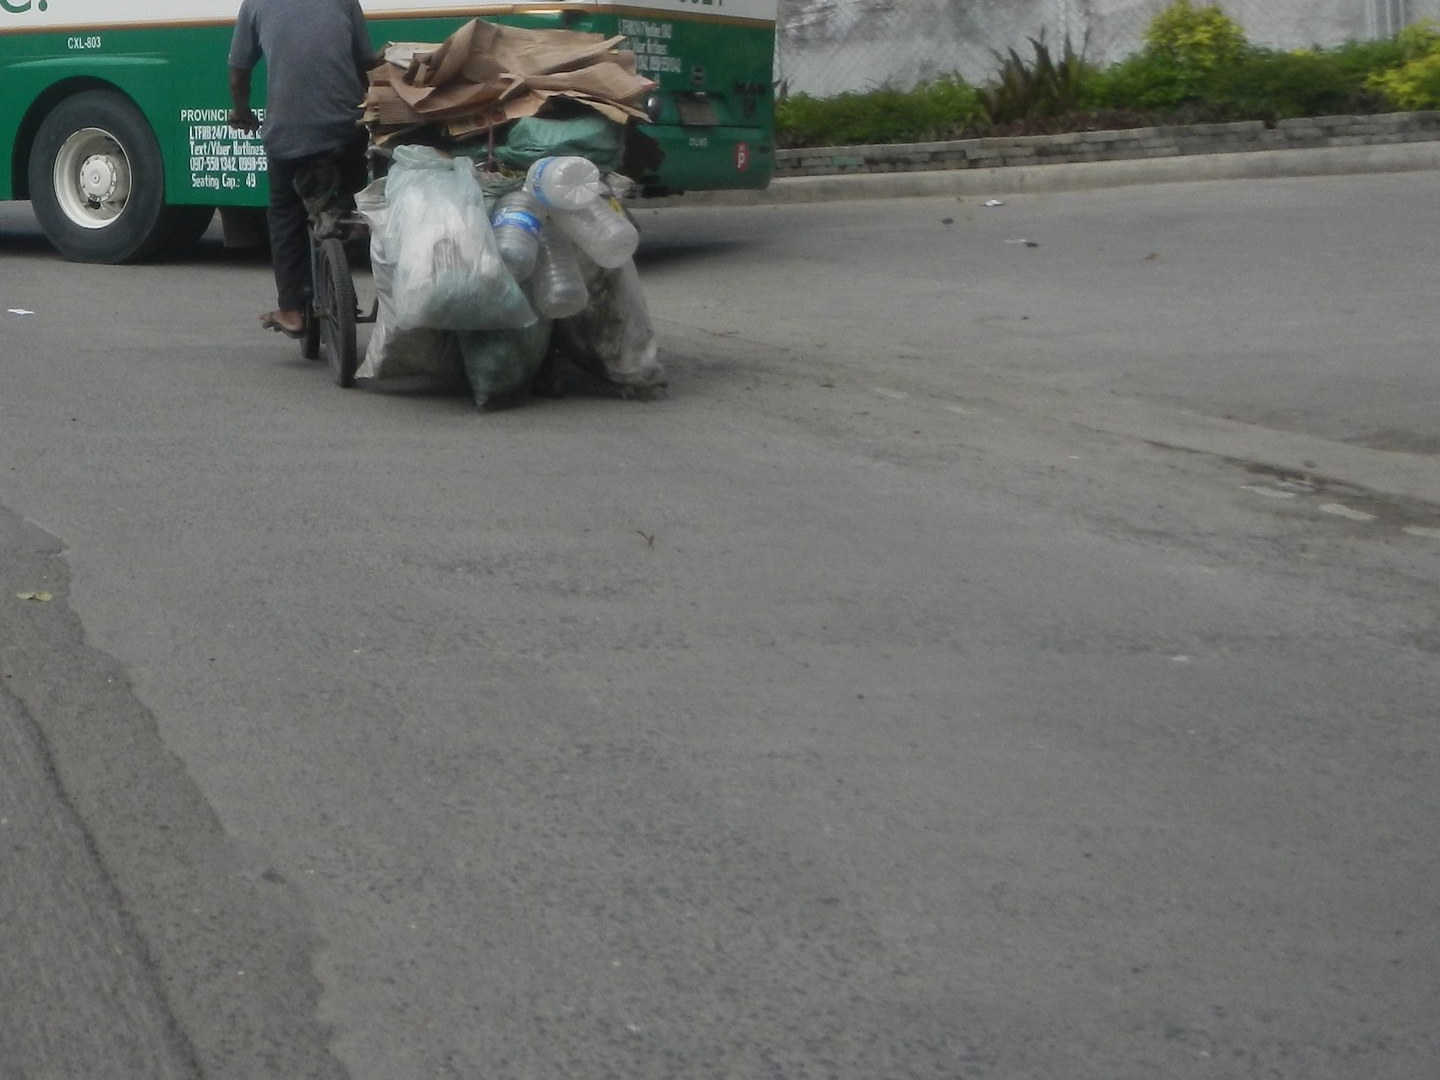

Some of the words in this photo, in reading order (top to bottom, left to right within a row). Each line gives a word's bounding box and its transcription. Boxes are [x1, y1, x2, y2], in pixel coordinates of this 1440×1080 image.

[67, 36, 101, 50] CXL-803
[180, 109, 232, 122] PROVINCI
[190, 140, 231, 156] Text/Viber
[238, 156, 268, 172] 0998-55
[191, 172, 220, 190] Seating
[245, 172, 257, 188] 49
